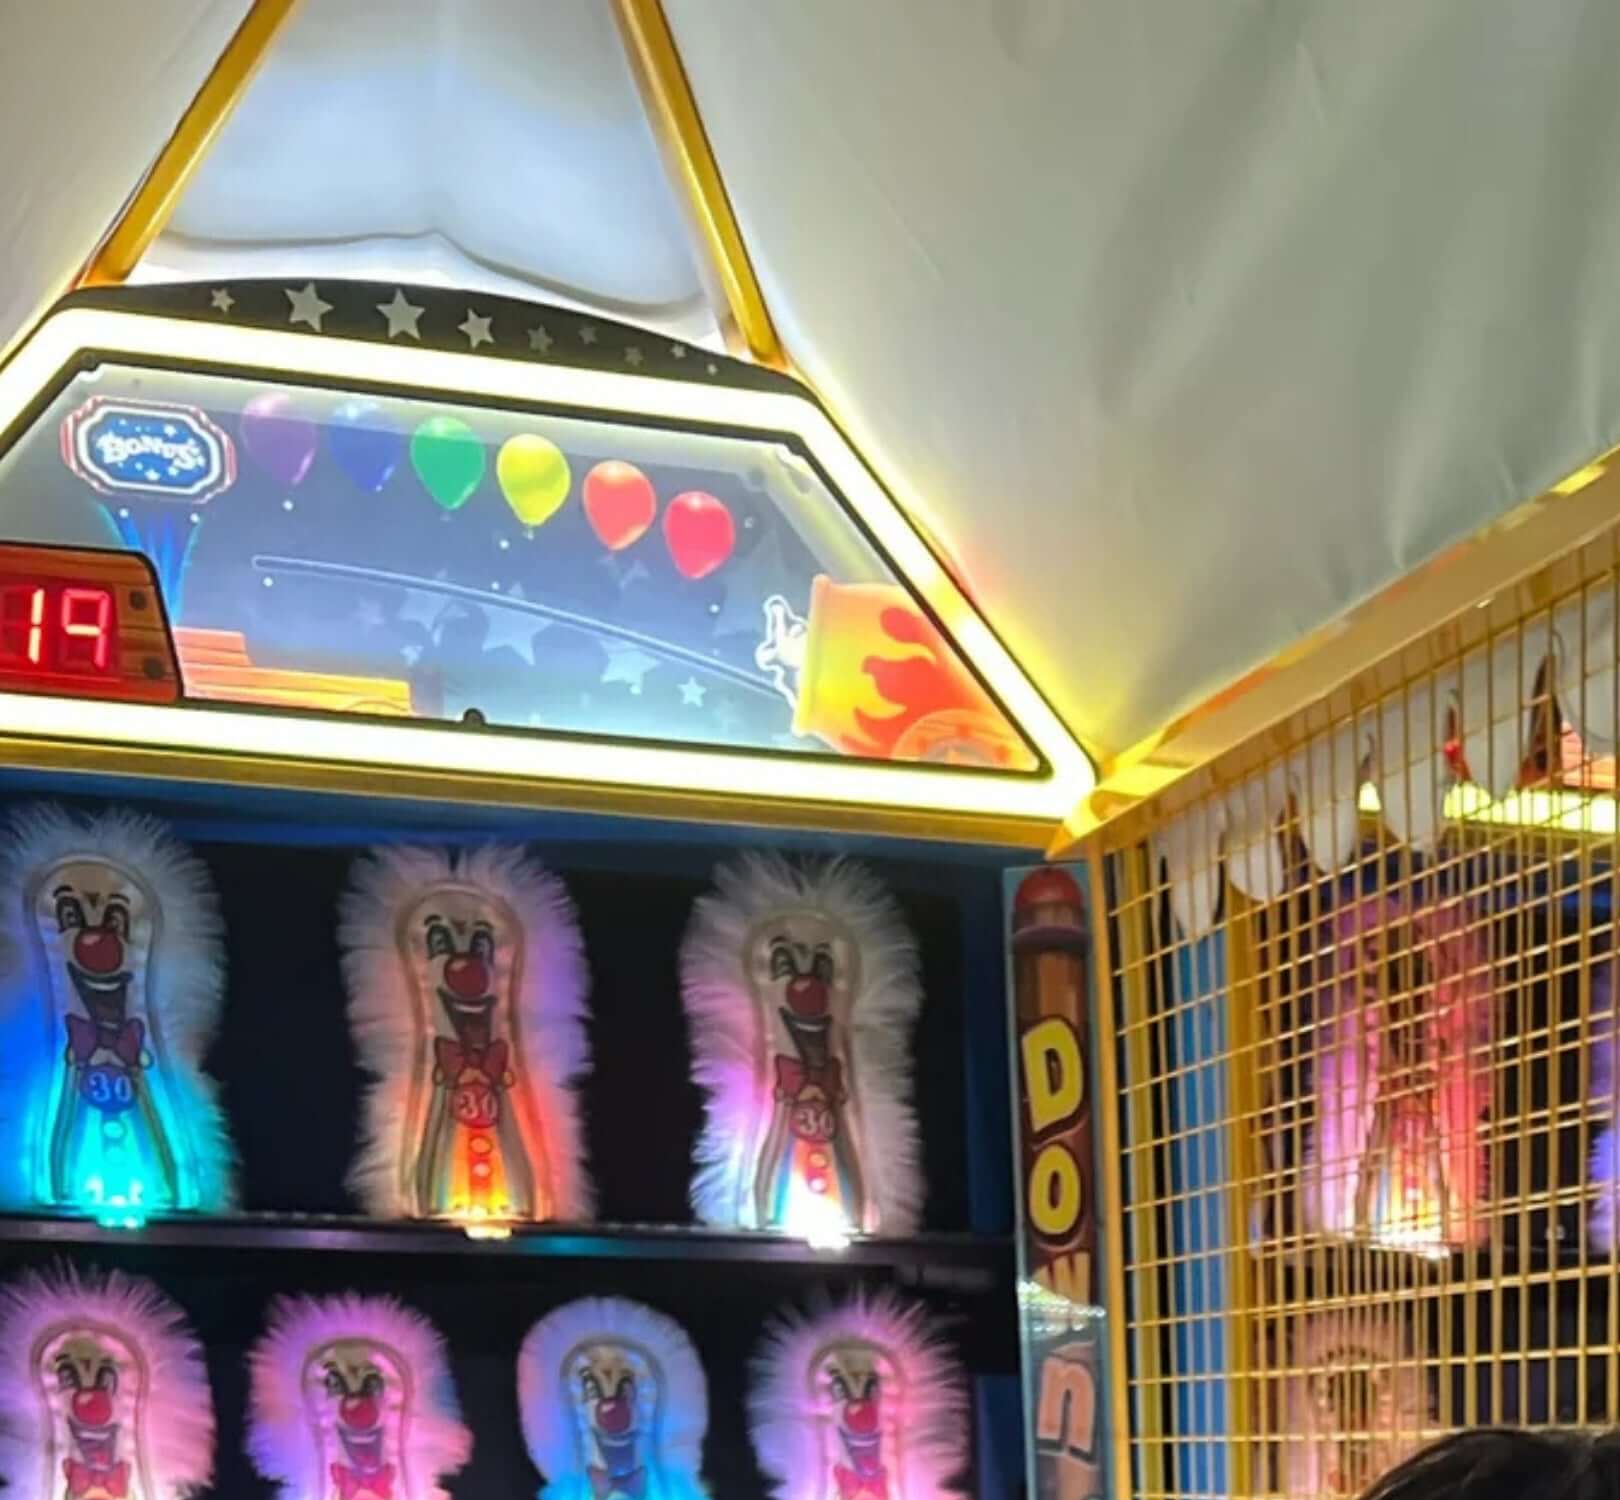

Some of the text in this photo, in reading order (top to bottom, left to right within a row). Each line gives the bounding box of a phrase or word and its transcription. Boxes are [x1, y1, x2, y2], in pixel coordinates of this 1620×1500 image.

[88, 1072, 133, 1102] 30
[456, 1091, 498, 1120] 30
[793, 1109, 833, 1137] 30
